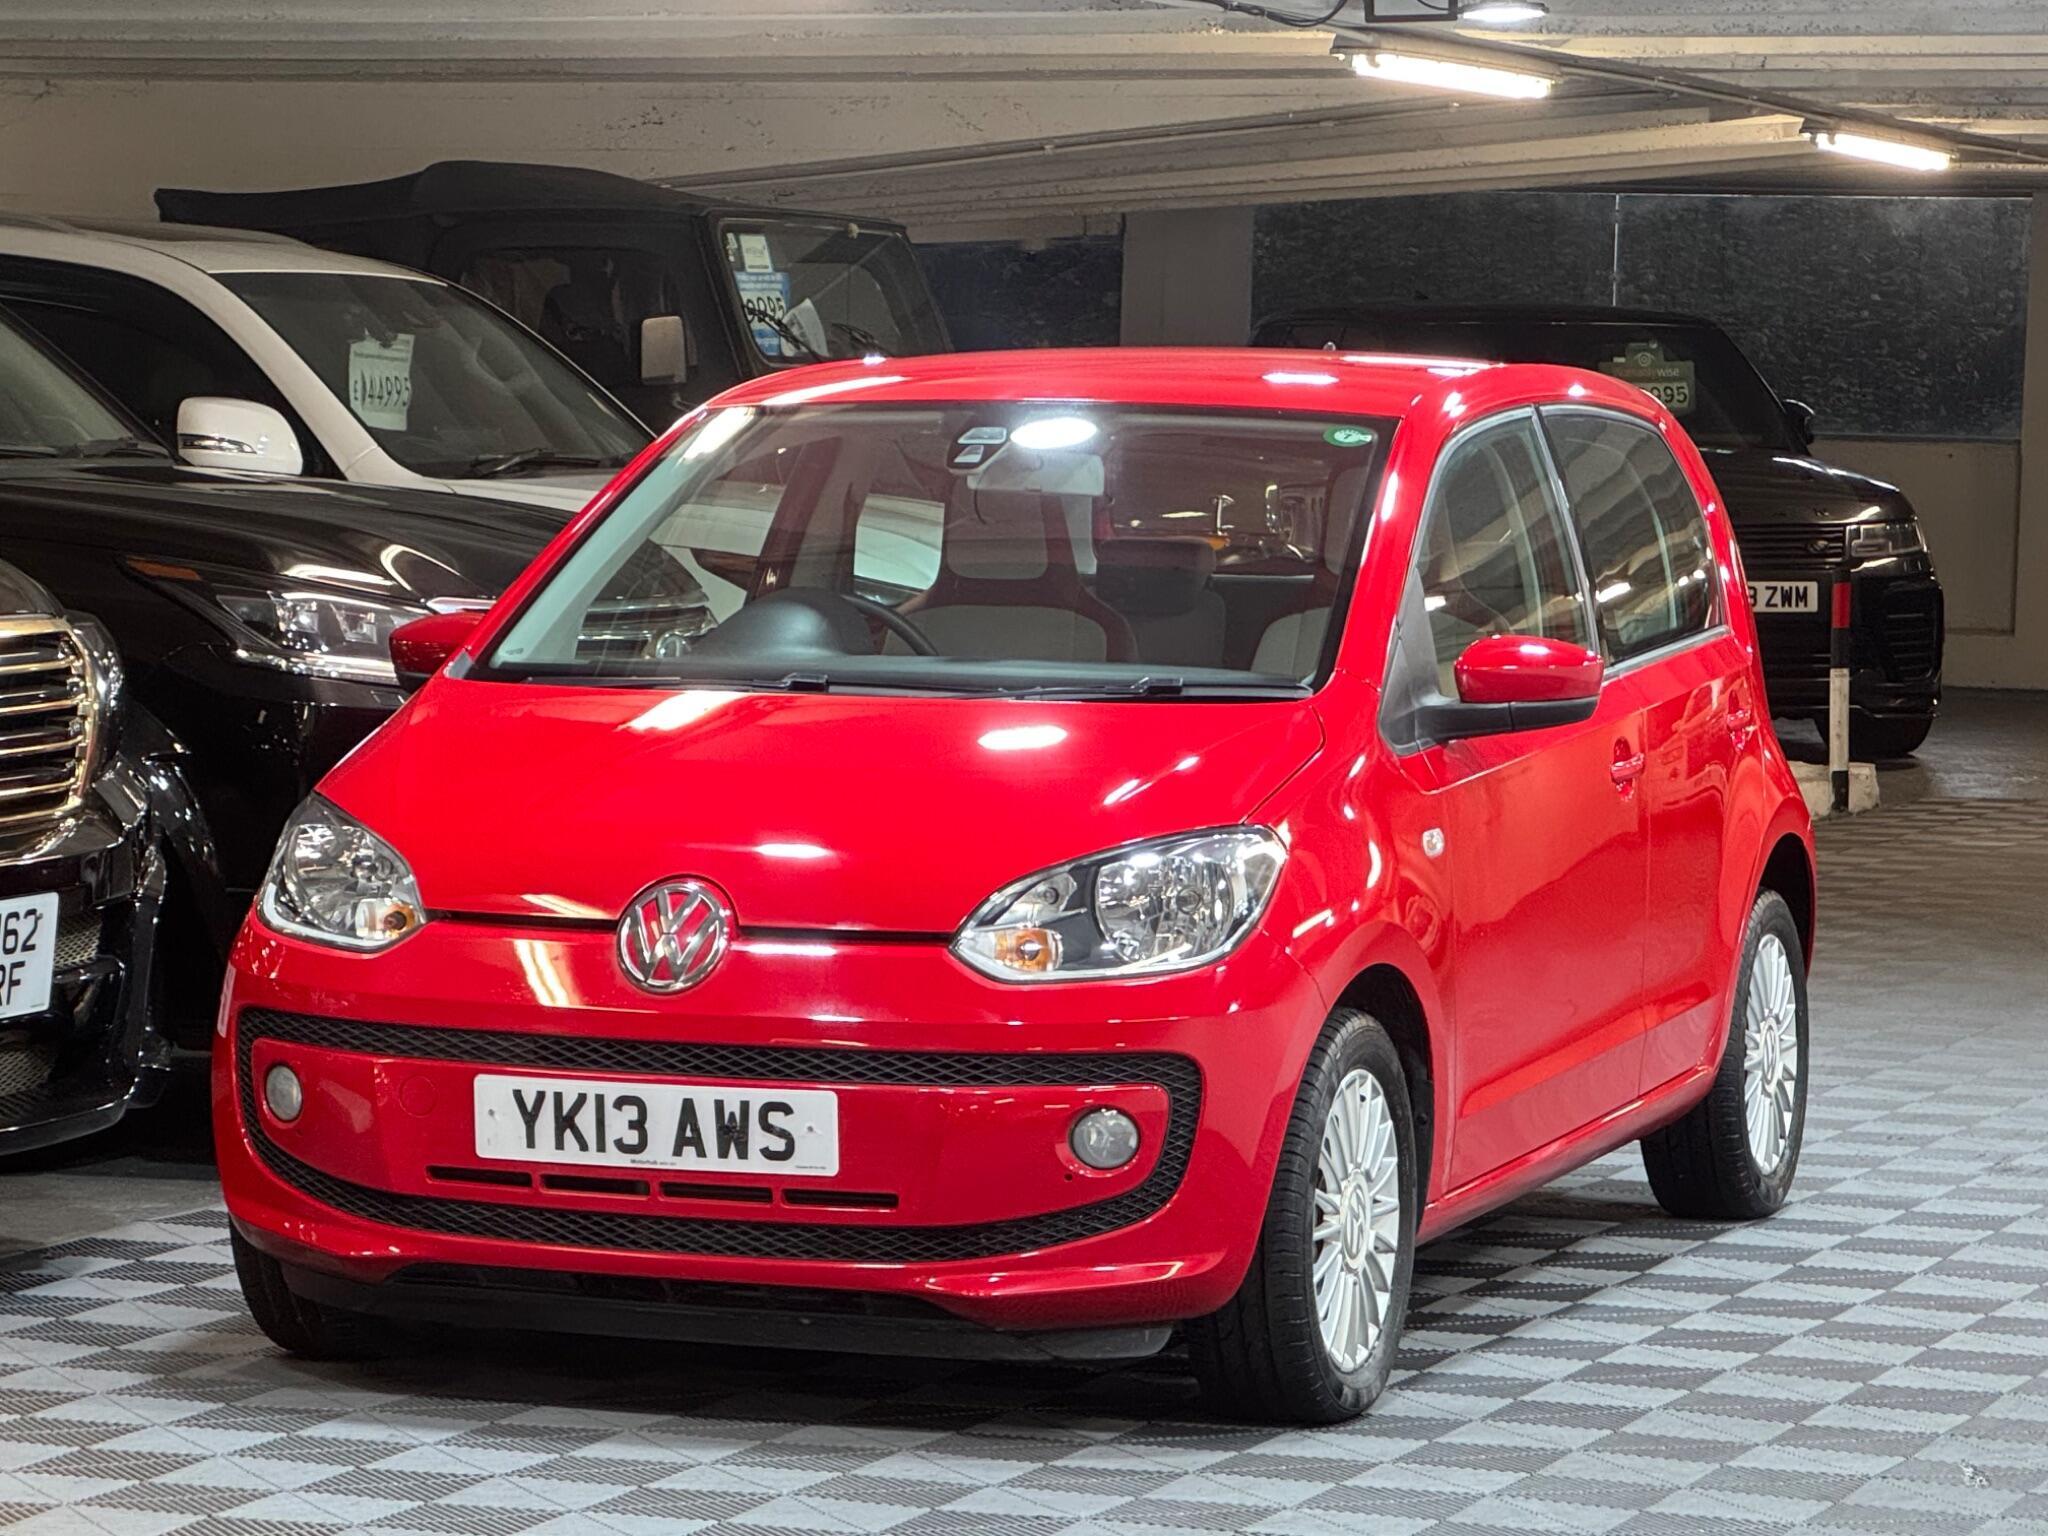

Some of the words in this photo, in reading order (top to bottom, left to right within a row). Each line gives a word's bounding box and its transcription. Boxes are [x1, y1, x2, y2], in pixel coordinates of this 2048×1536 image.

[1765, 586, 1808, 608] ZWM
[512, 1089, 648, 1155] YK13
[672, 1098, 796, 1161] AWS
